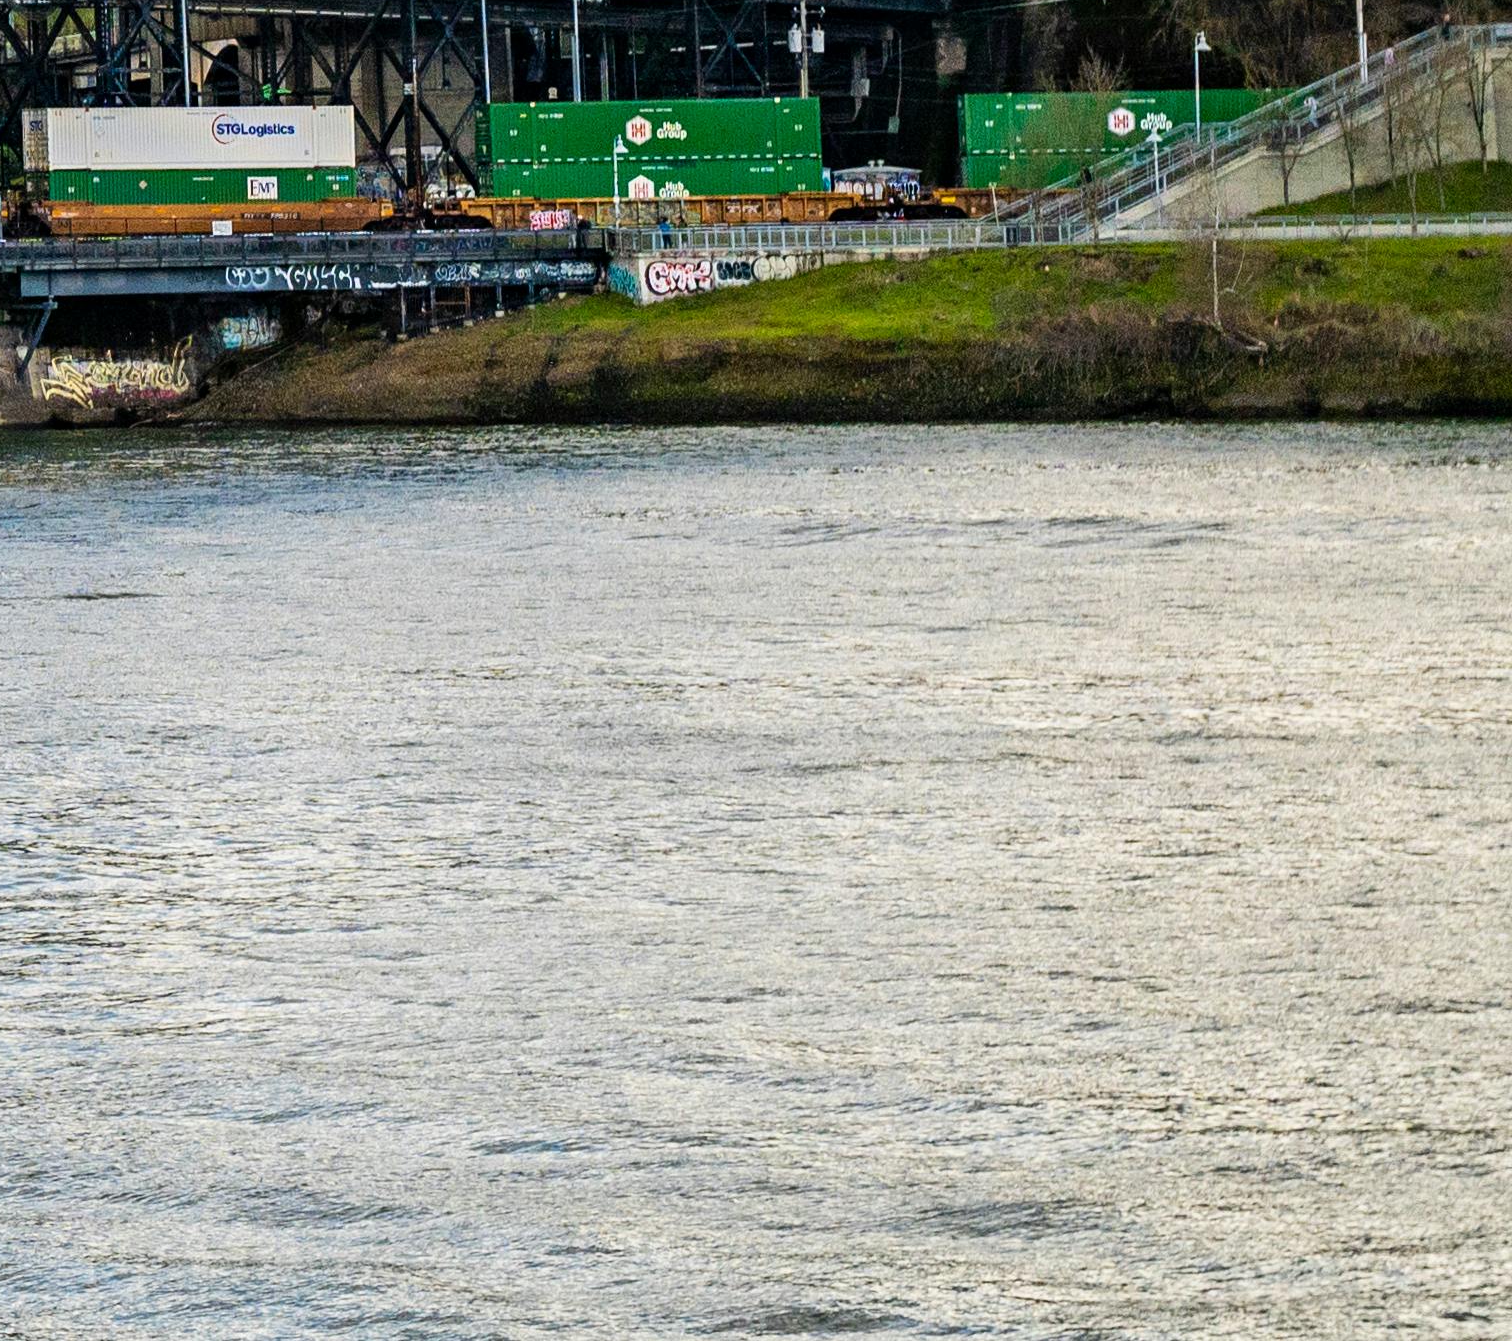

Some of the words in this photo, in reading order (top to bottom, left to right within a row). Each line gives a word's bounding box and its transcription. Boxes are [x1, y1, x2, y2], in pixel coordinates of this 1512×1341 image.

[216, 123, 295, 138] STGLogistics
[663, 121, 682, 132] Hub
[656, 128, 688, 141] Group
[250, 179, 275, 197] EMP
[665, 181, 685, 191] Hub
